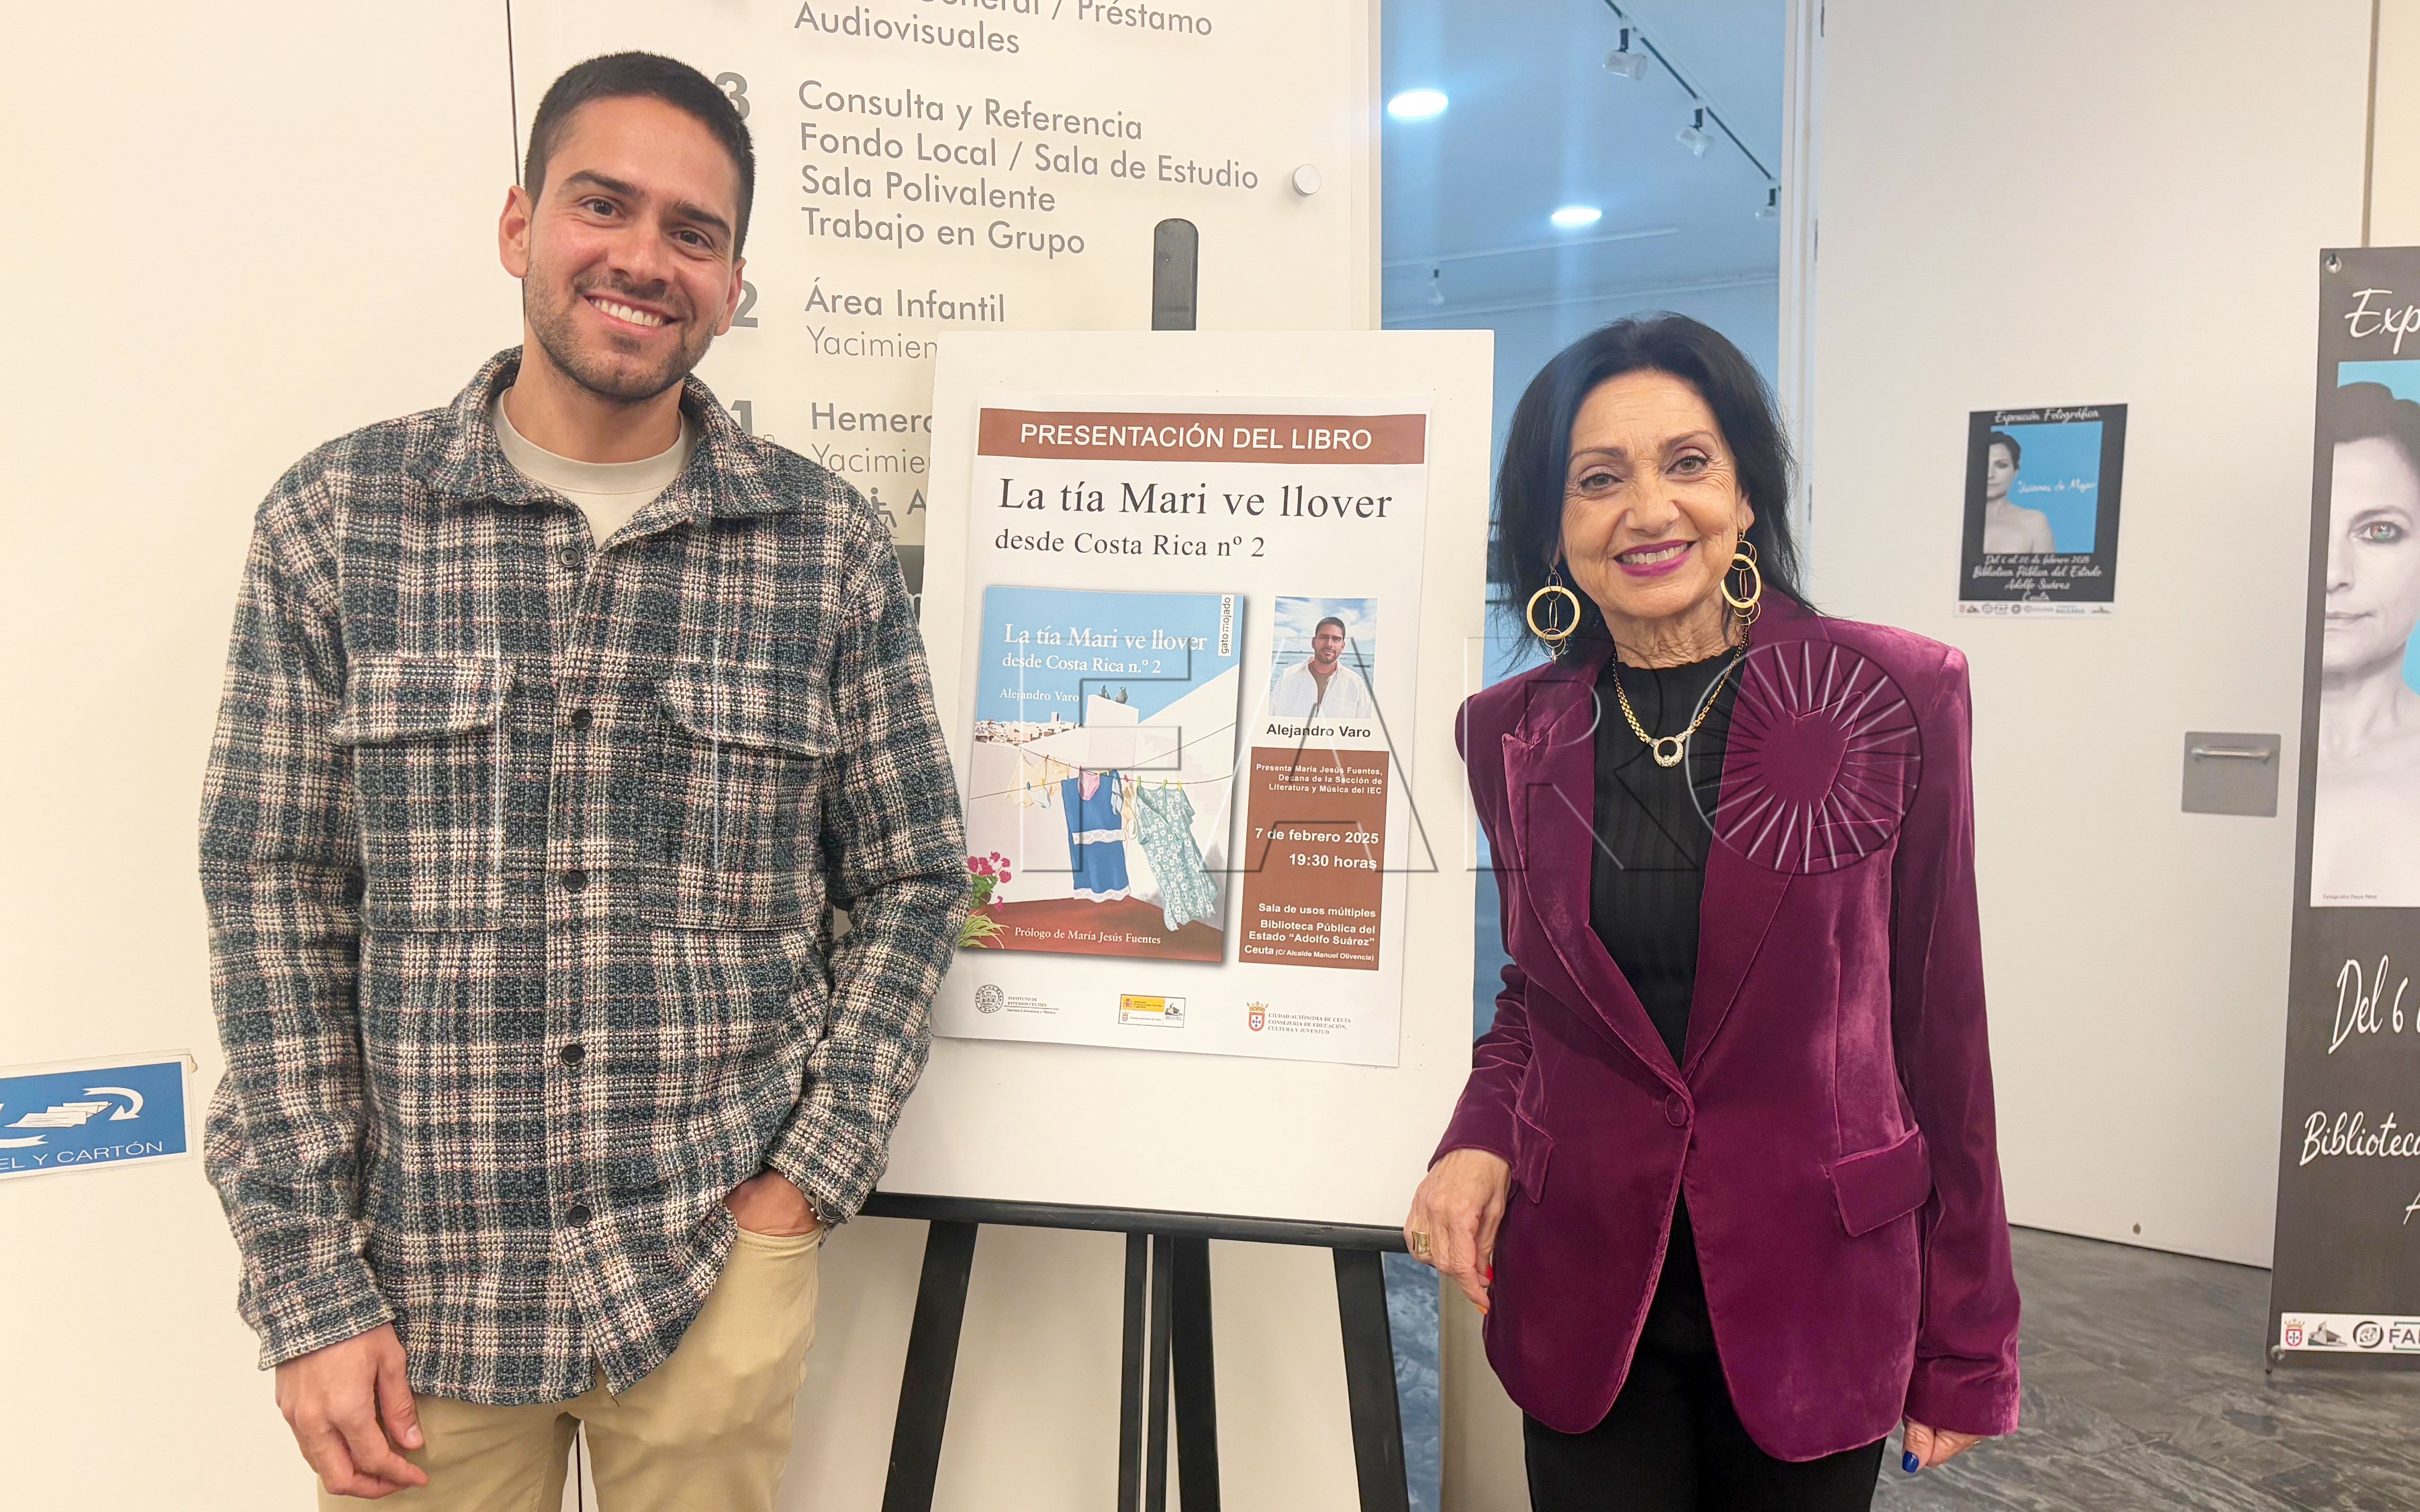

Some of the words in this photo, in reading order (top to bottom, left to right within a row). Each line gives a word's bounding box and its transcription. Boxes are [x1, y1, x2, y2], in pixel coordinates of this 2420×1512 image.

[794, 2, 1020, 53] Audiovisuales
[1078, 0, 1212, 35] Préstamo
[715, 71, 750, 120] 3
[798, 80, 943, 120] Consulta
[956, 104, 973, 130] y
[985, 98, 1141, 139] Referencia
[801, 122, 903, 158] Fondo
[917, 133, 996, 166] Local
[1009, 141, 1022, 171] /
[1035, 143, 1098, 175] Sala
[1111, 150, 1146, 179] de
[1158, 155, 1258, 189] Estudio
[802, 165, 871, 198] Sala
[886, 172, 1055, 212] Polivalente
[801, 207, 924, 249] Trabajo
[937, 225, 975, 246] en
[988, 221, 1085, 259] Grupo
[731, 280, 758, 328] 2
[804, 277, 882, 315] Área
[897, 290, 1004, 322] Infantil
[1020, 422, 1224, 447] PRESENTACIÓN
[1233, 428, 1284, 449] DEL
[1291, 428, 1372, 450] LIBRO
[811, 443, 930, 474] Yacimie
[998, 478, 1046, 510] La
[1060, 481, 1105, 512] tía
[1118, 482, 1207, 514] Mari
[1222, 494, 1264, 515] ve
[1279, 485, 1392, 518] llover
[995, 528, 1064, 551] desde
[1074, 533, 1142, 554] Costa
[1152, 534, 1208, 556] Rica
[1251, 537, 1264, 557] 2
[1003, 623, 1030, 644] La
[1036, 625, 1061, 645] tía
[1068, 627, 1118, 648] Mari
[1124, 635, 1146, 650] ve
[1151, 629, 1208, 651] llover
[1221, 634, 1229, 654] gato
[1002, 653, 1042, 668] desde
[1046, 655, 1088, 671] Costa
[1092, 657, 1124, 673] Rica
[1151, 660, 1161, 674] 2
[1000, 688, 1051, 702] Alejandro
[1054, 691, 1080, 702] Varo
[1266, 723, 1335, 739] Alejandro
[1339, 726, 1371, 738] Varo
[1256, 764, 1292, 772] Presenta
[1295, 765, 1317, 773] María
[1320, 766, 1344, 774] Jesús
[1347, 767, 1383, 776] Fuentes,
[1278, 774, 1309, 782] Decana
[1312, 774, 1322, 783] de
[1335, 775, 1369, 784] Sección
[1372, 777, 1383, 785] de
[1269, 783, 1309, 792] Literatura
[1319, 785, 1348, 794] Música
[1351, 786, 1364, 794] del
[1255, 827, 1263, 839] 7
[1267, 828, 1285, 840] de
[1288, 829, 1341, 843] febrero
[1344, 832, 1379, 844] 2025
[1289, 853, 1329, 867] 19:30
[1333, 856, 1377, 869] horas
[1258, 903, 1281, 912] Sala
[1284, 904, 1296, 913] de
[1299, 907, 1325, 915] usos
[1328, 906, 1376, 919] múltiples
[1015, 927, 1051, 939] Prólogo
[1054, 929, 1065, 938] de
[1068, 930, 1096, 941] María
[1098, 931, 1123, 943] Jesús
[1125, 933, 1161, 944] Fuentes
[1249, 931, 1286, 941] Estado
[1260, 919, 1313, 931] Biblioteca
[1316, 922, 1356, 933] Pública
[1359, 925, 1375, 934] del
[1244, 945, 1274, 955] Ceuta
[1287, 949, 1312, 958] Alcalde
[1314, 951, 1339, 959] Manuel
[1340, 952, 1374, 962] Olivencia)
[2328, 954, 2389, 1055] Del
[2392, 977, 2408, 1033] 6
[32, 1153, 48, 1166] Y
[57, 1141, 163, 1163] CARTÓN
